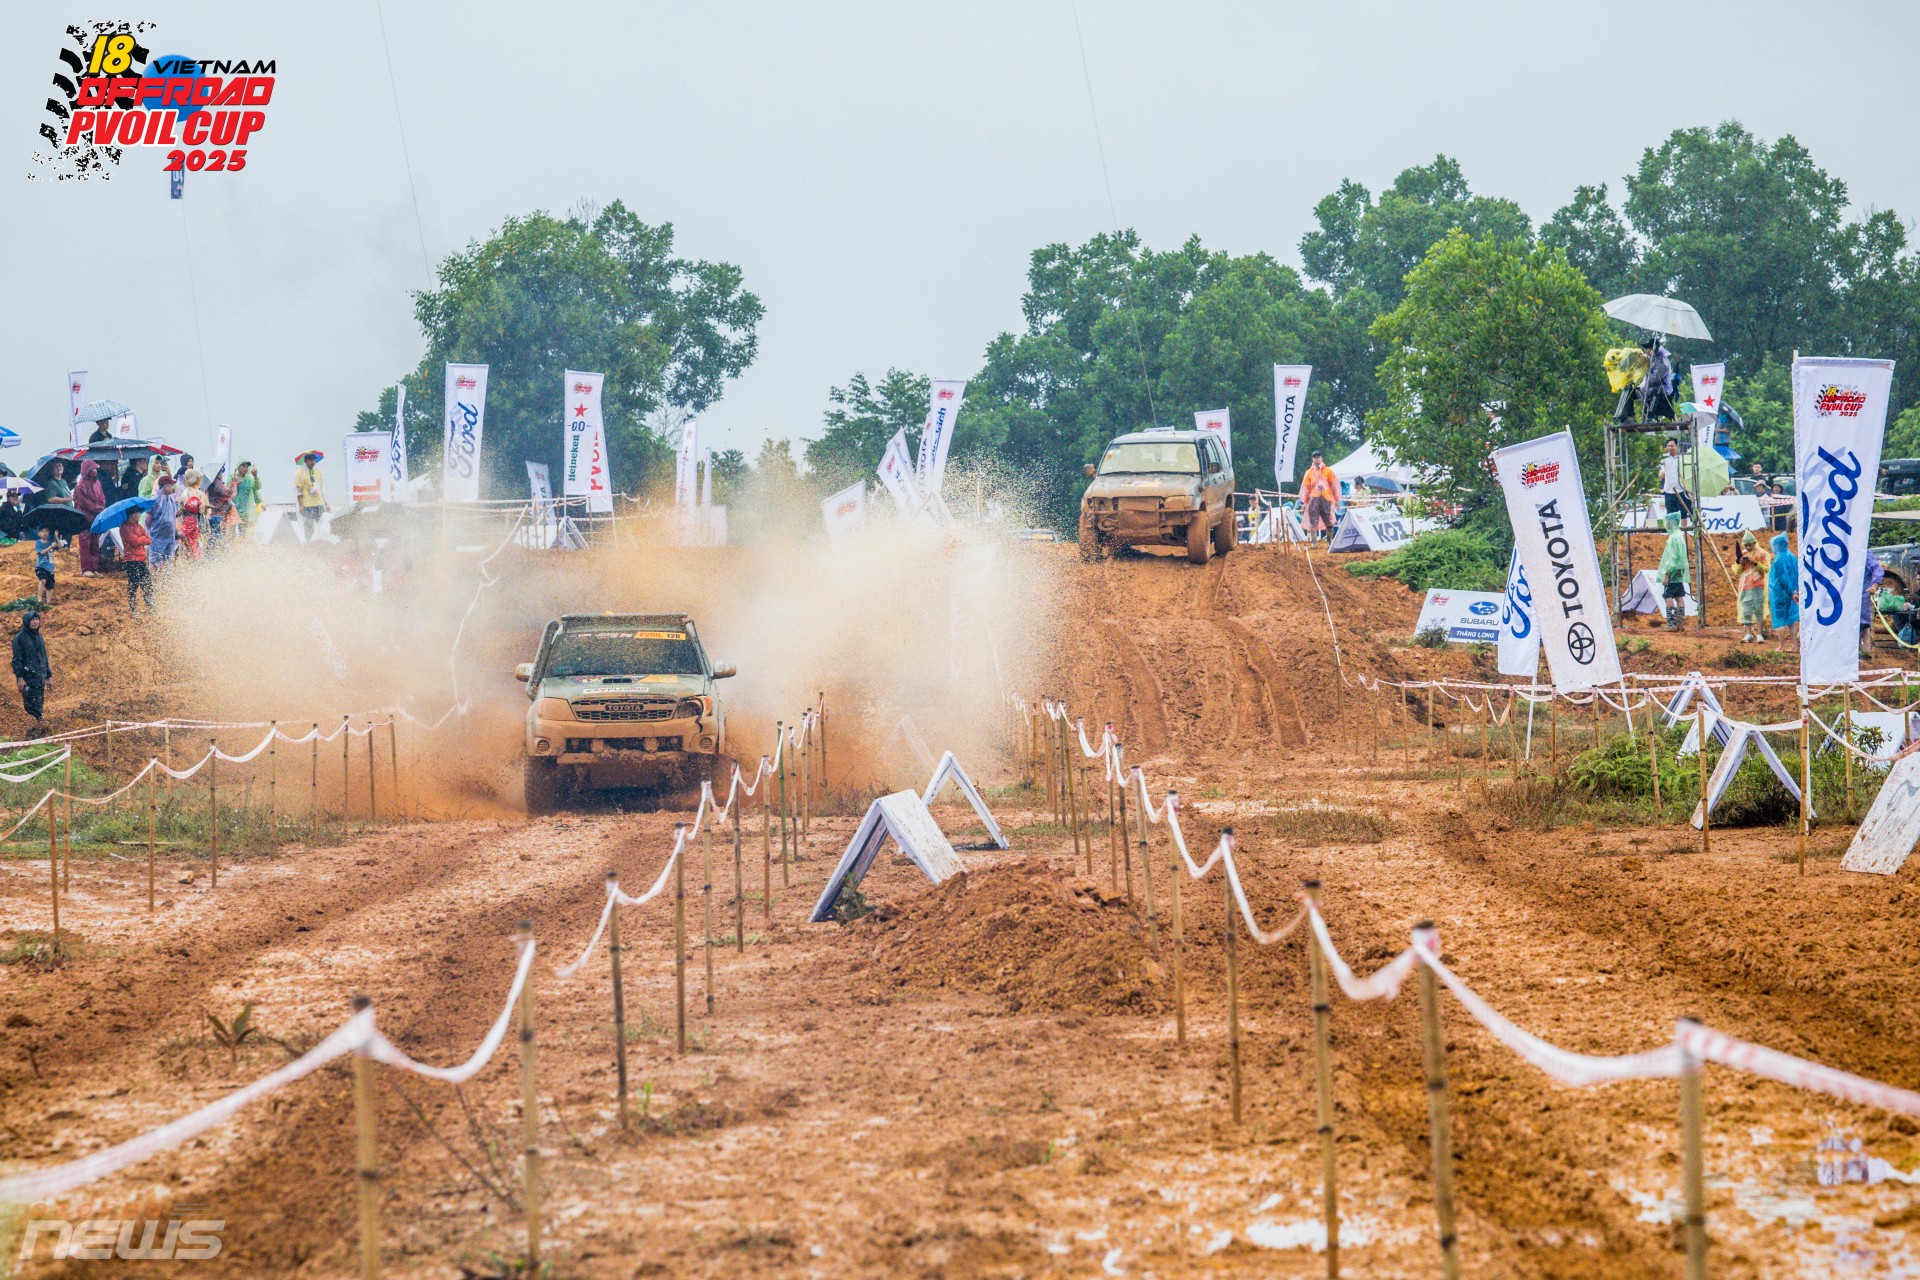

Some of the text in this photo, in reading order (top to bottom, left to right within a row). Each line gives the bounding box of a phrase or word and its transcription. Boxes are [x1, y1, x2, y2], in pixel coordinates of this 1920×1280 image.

[1844, 403, 1863, 411] CUP
[568, 434, 580, 482] Heineken
[1537, 498, 1584, 619] TOYOTA
[1801, 445, 1862, 627] Ford
[1460, 617, 1500, 626] SUBARU
